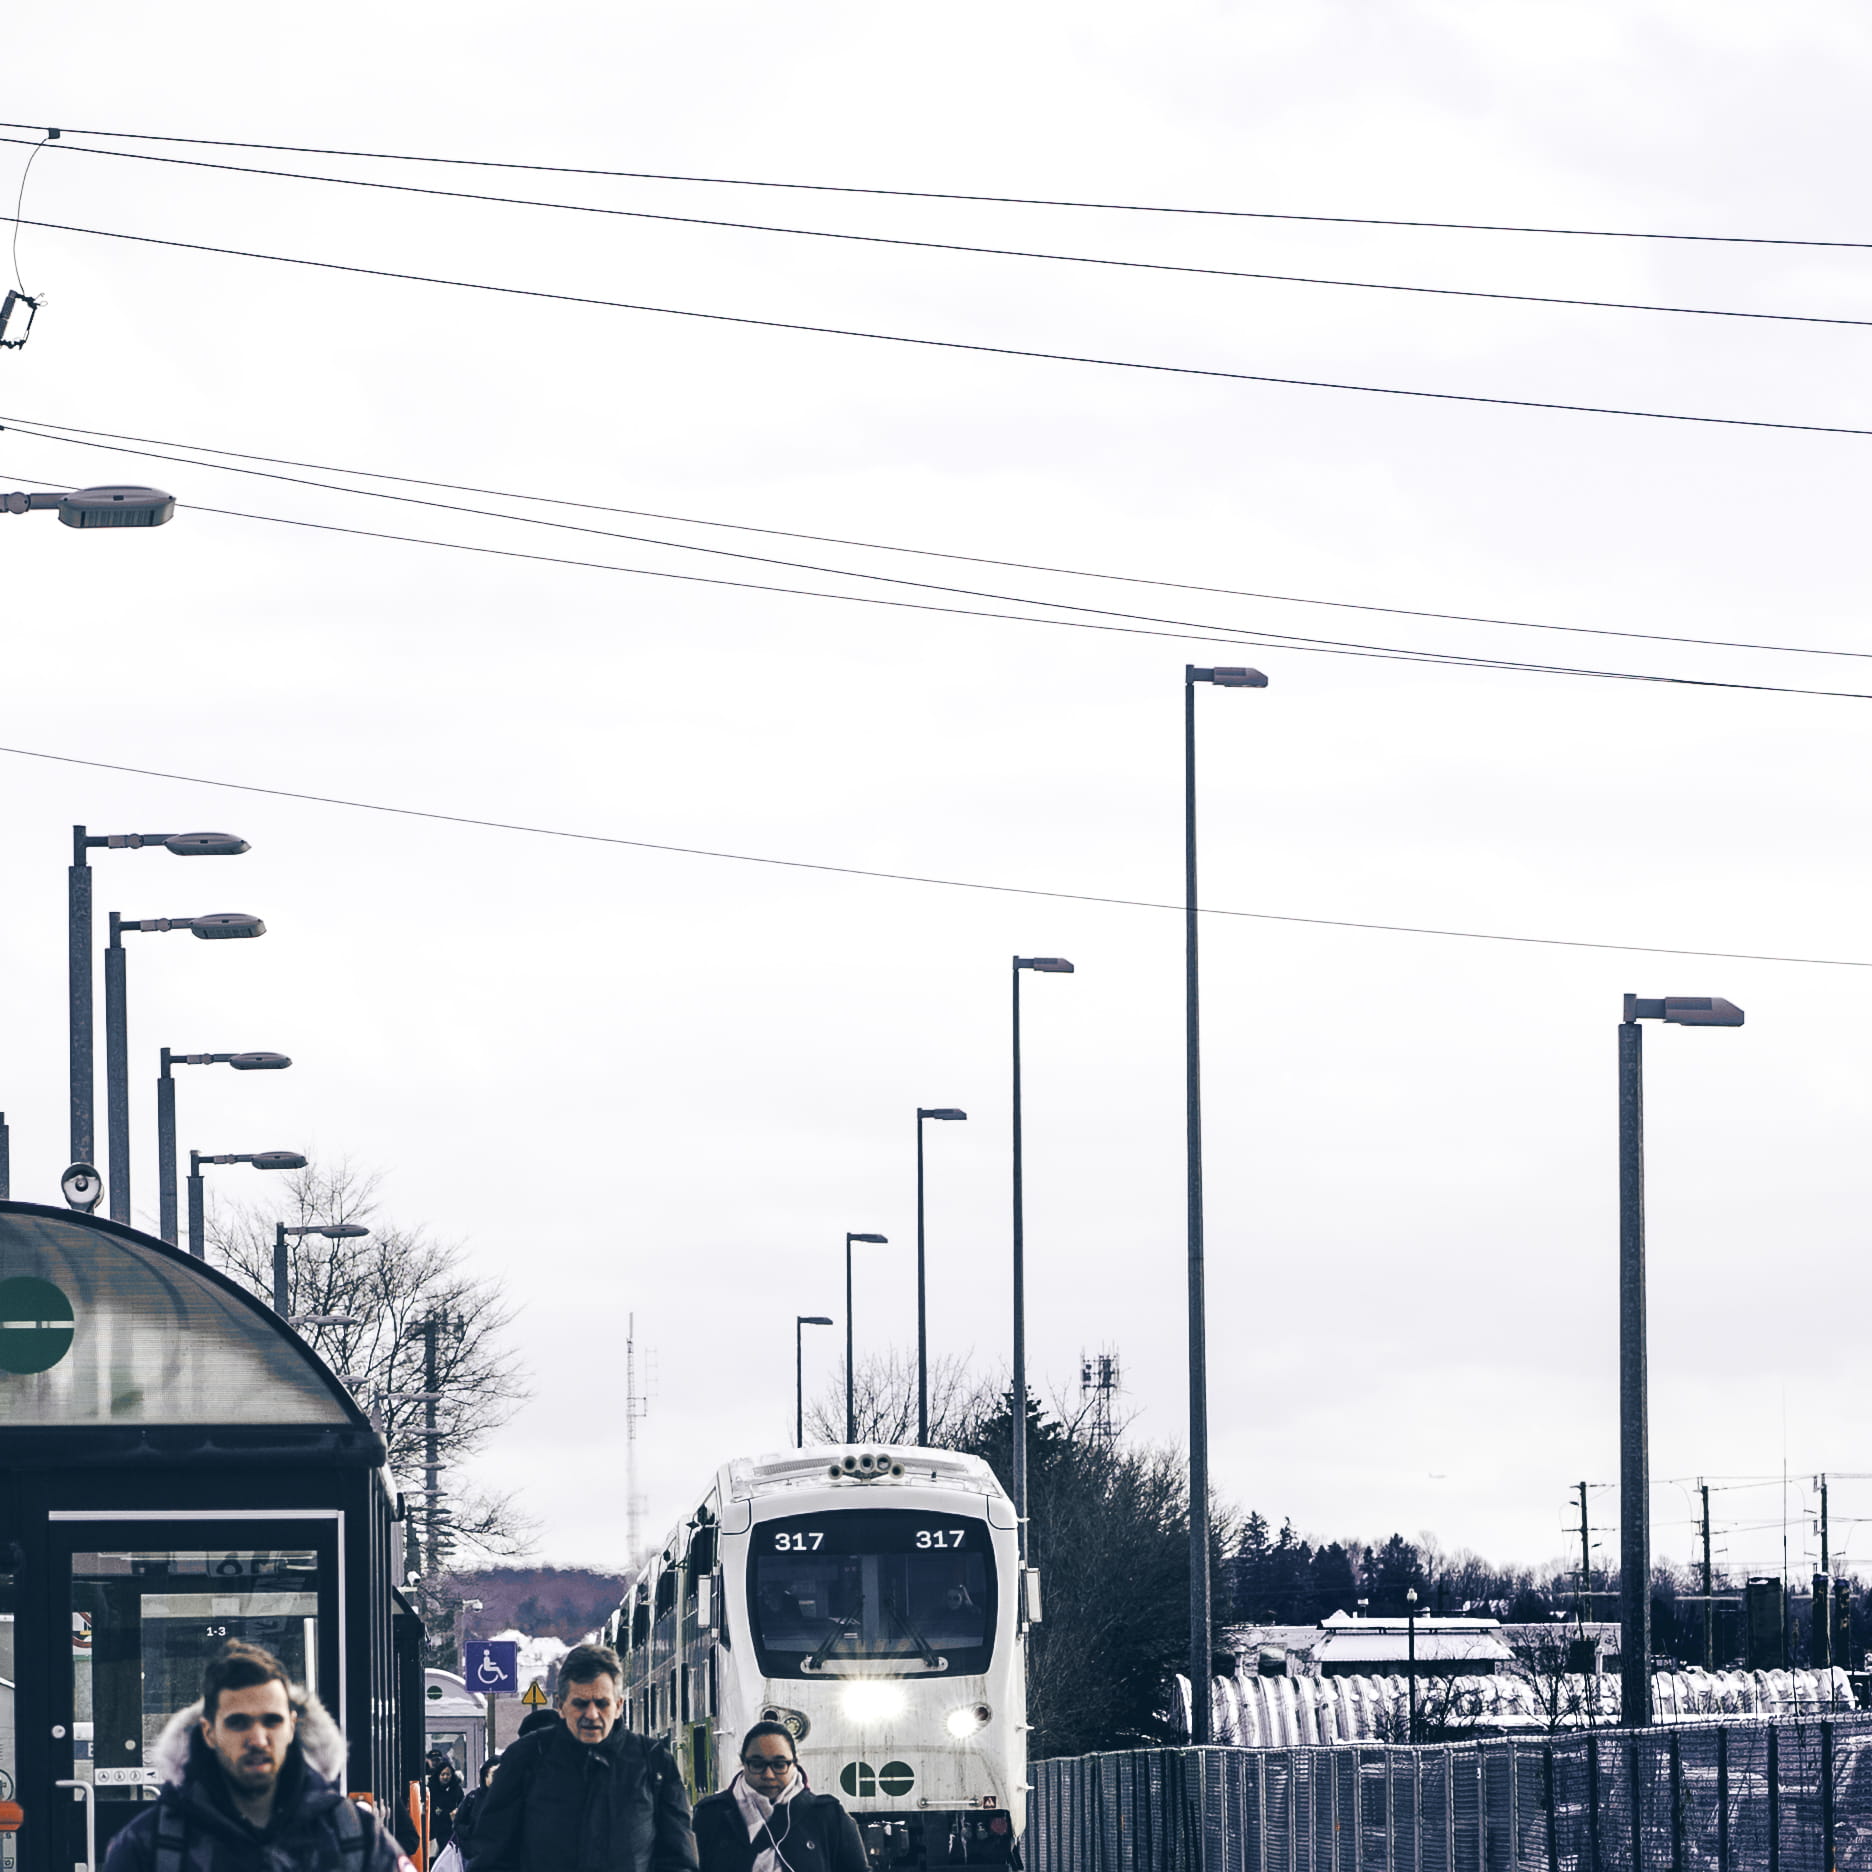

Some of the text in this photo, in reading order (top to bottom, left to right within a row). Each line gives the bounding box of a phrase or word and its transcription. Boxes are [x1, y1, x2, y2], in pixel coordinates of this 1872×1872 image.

[774, 1532, 825, 1551] 317
[915, 1529, 966, 1549] 317
[206, 1626, 227, 1637] 1-3
